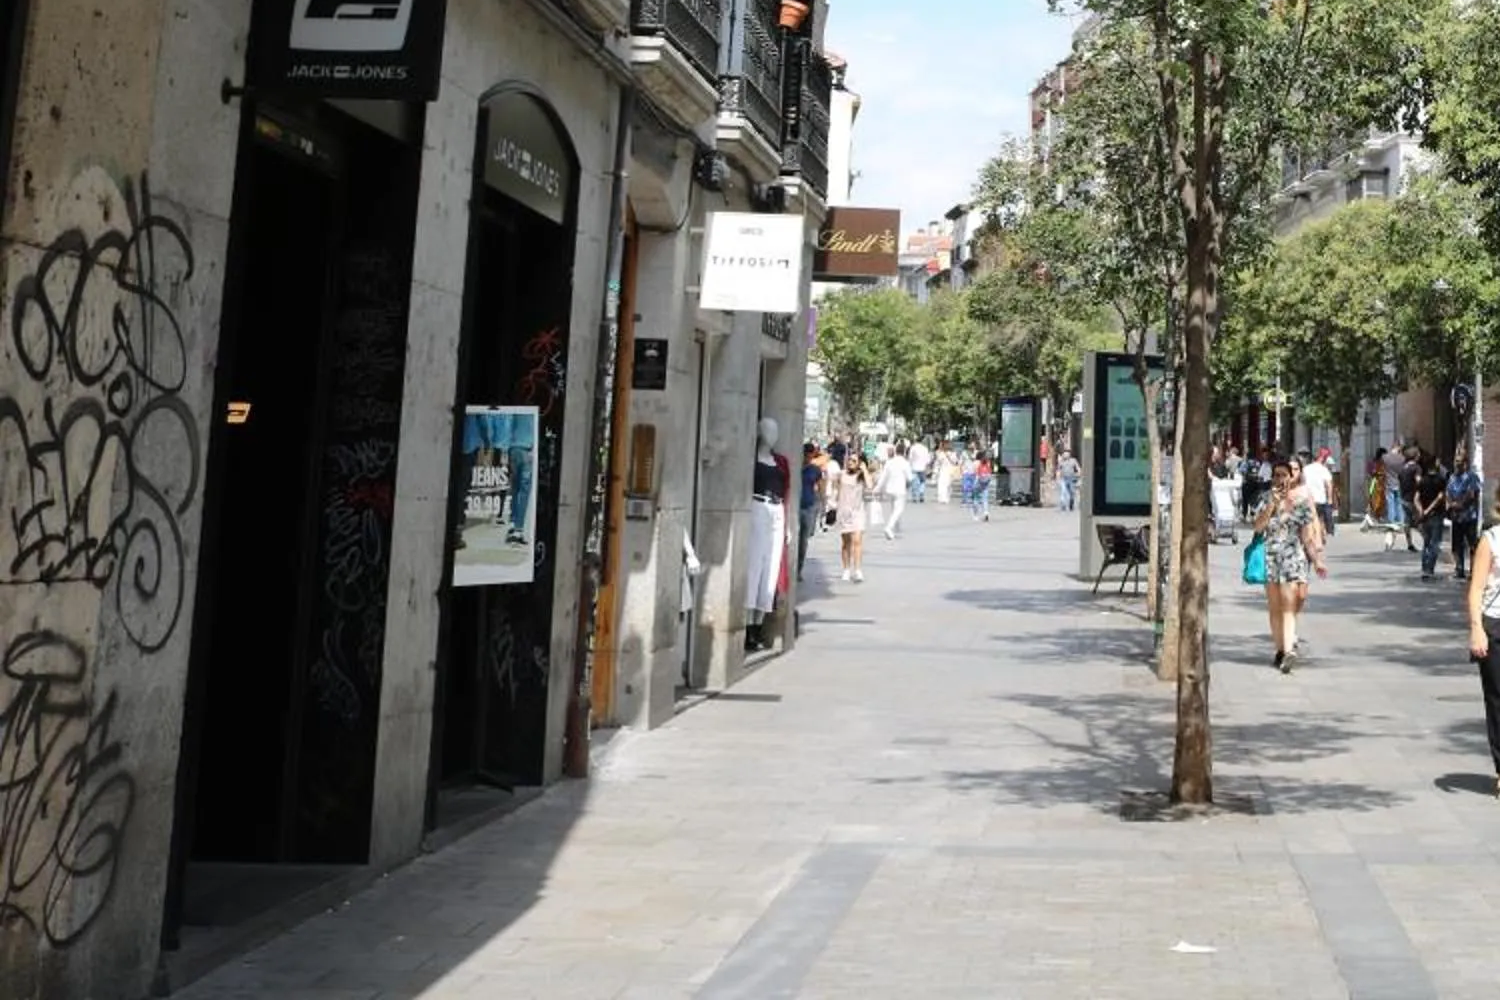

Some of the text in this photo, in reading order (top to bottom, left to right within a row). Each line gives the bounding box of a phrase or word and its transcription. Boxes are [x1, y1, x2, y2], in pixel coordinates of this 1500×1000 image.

[351, 66, 408, 80] JONES
[819, 229, 877, 254] Lindt
[470, 465, 509, 487] JEANS
